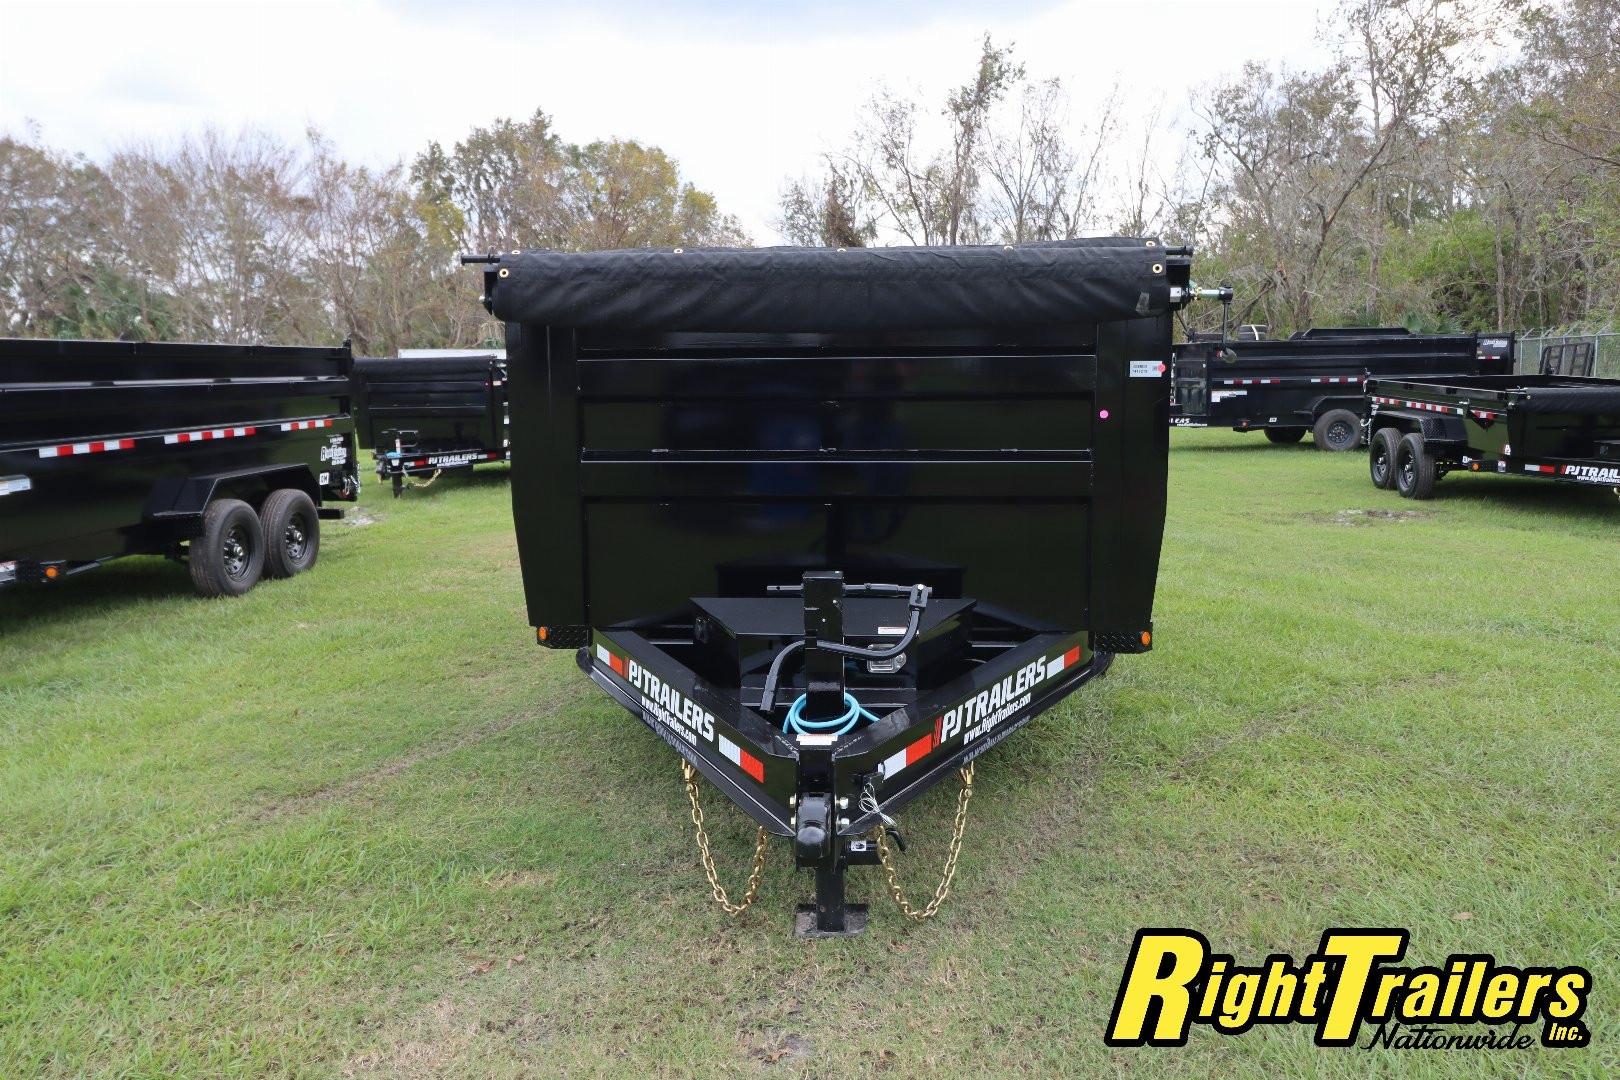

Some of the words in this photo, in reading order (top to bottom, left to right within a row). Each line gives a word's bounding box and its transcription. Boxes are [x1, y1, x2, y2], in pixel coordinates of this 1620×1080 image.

[438, 452, 478, 464] TRAILERS
[1565, 464, 1581, 476] PJ
[628, 659, 642, 689] PJ
[642, 668, 715, 743] TRAILERS
[641, 696, 697, 747] www.RightTrailers.com
[941, 704, 964, 744] PJ
[964, 655, 1047, 727] TRAILERS
[963, 692, 1032, 746] www.RightTrailers.com
